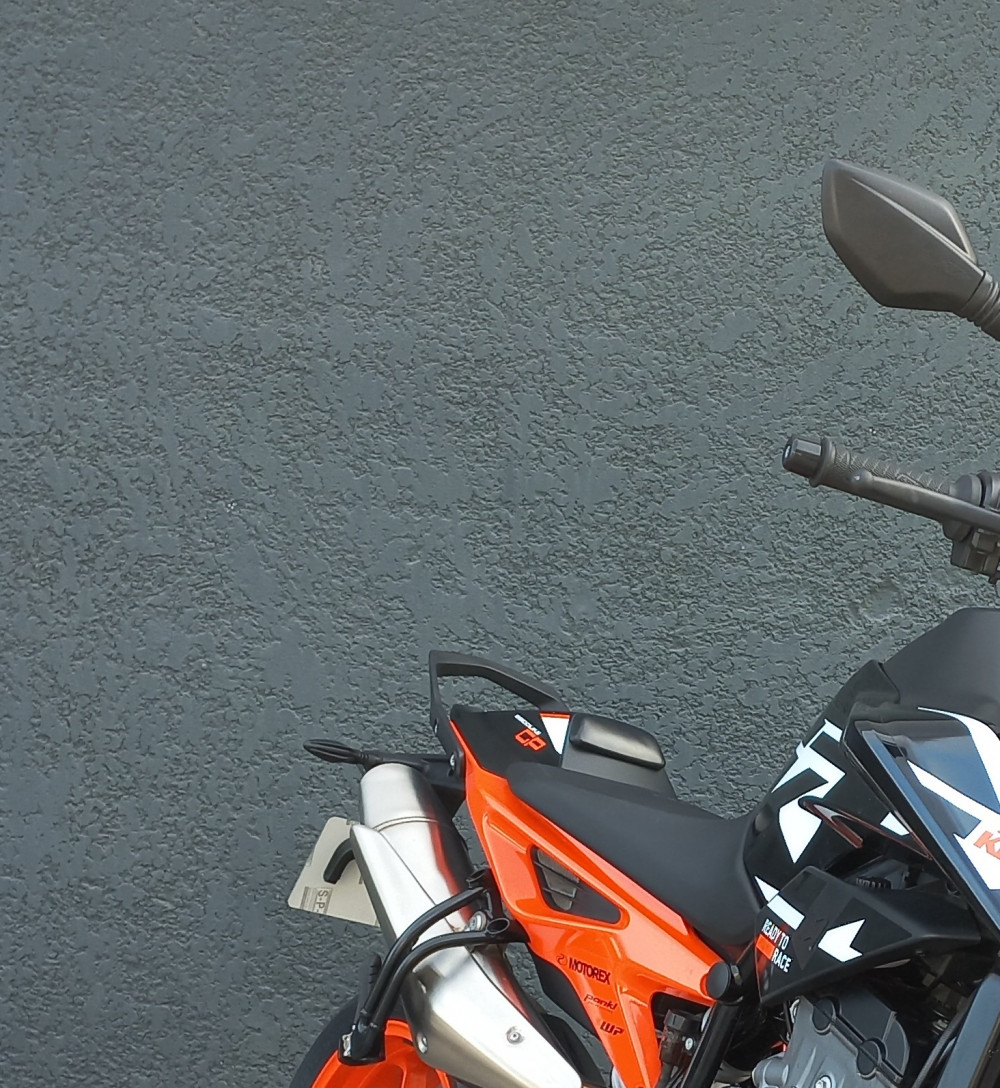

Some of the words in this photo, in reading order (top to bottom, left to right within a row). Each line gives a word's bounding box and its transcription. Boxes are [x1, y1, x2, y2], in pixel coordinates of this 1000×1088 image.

[514, 728, 547, 751] GP
[761, 918, 782, 944] READY
[778, 932, 790, 951] TO
[568, 957, 612, 986] MOTOREX
[771, 947, 792, 973] RACE
[600, 1021, 624, 1036] WP
